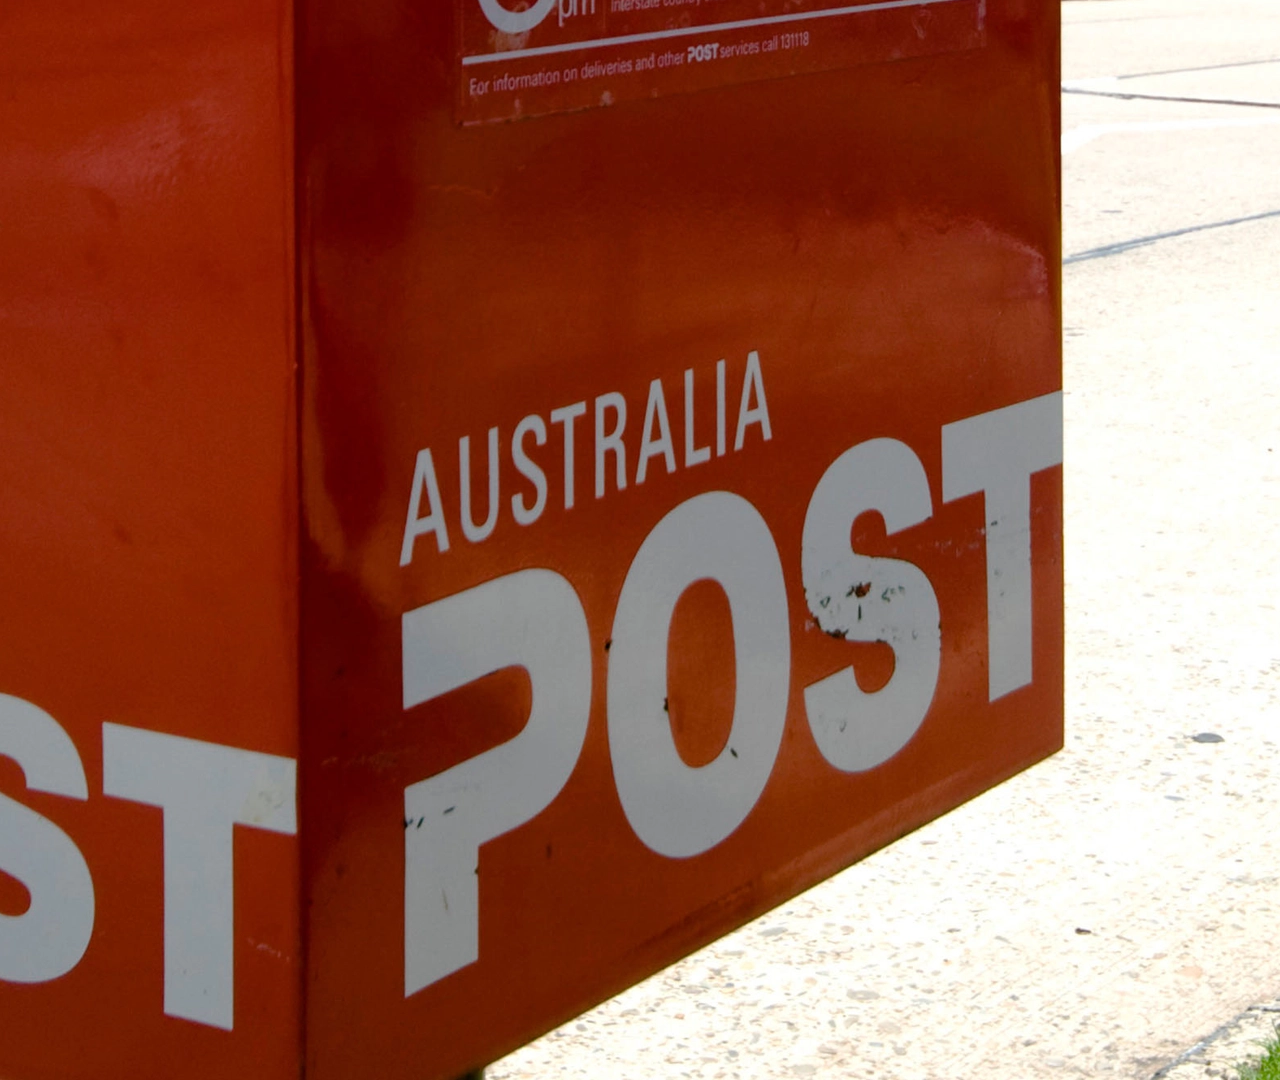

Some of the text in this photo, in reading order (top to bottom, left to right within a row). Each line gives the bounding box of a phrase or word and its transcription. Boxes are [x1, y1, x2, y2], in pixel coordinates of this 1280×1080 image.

[470, 30, 810, 97] For information on deliveries and other POST services call 131118
[398, 350, 773, 568] AUSTRALIA
[402, 389, 1063, 999] POST
